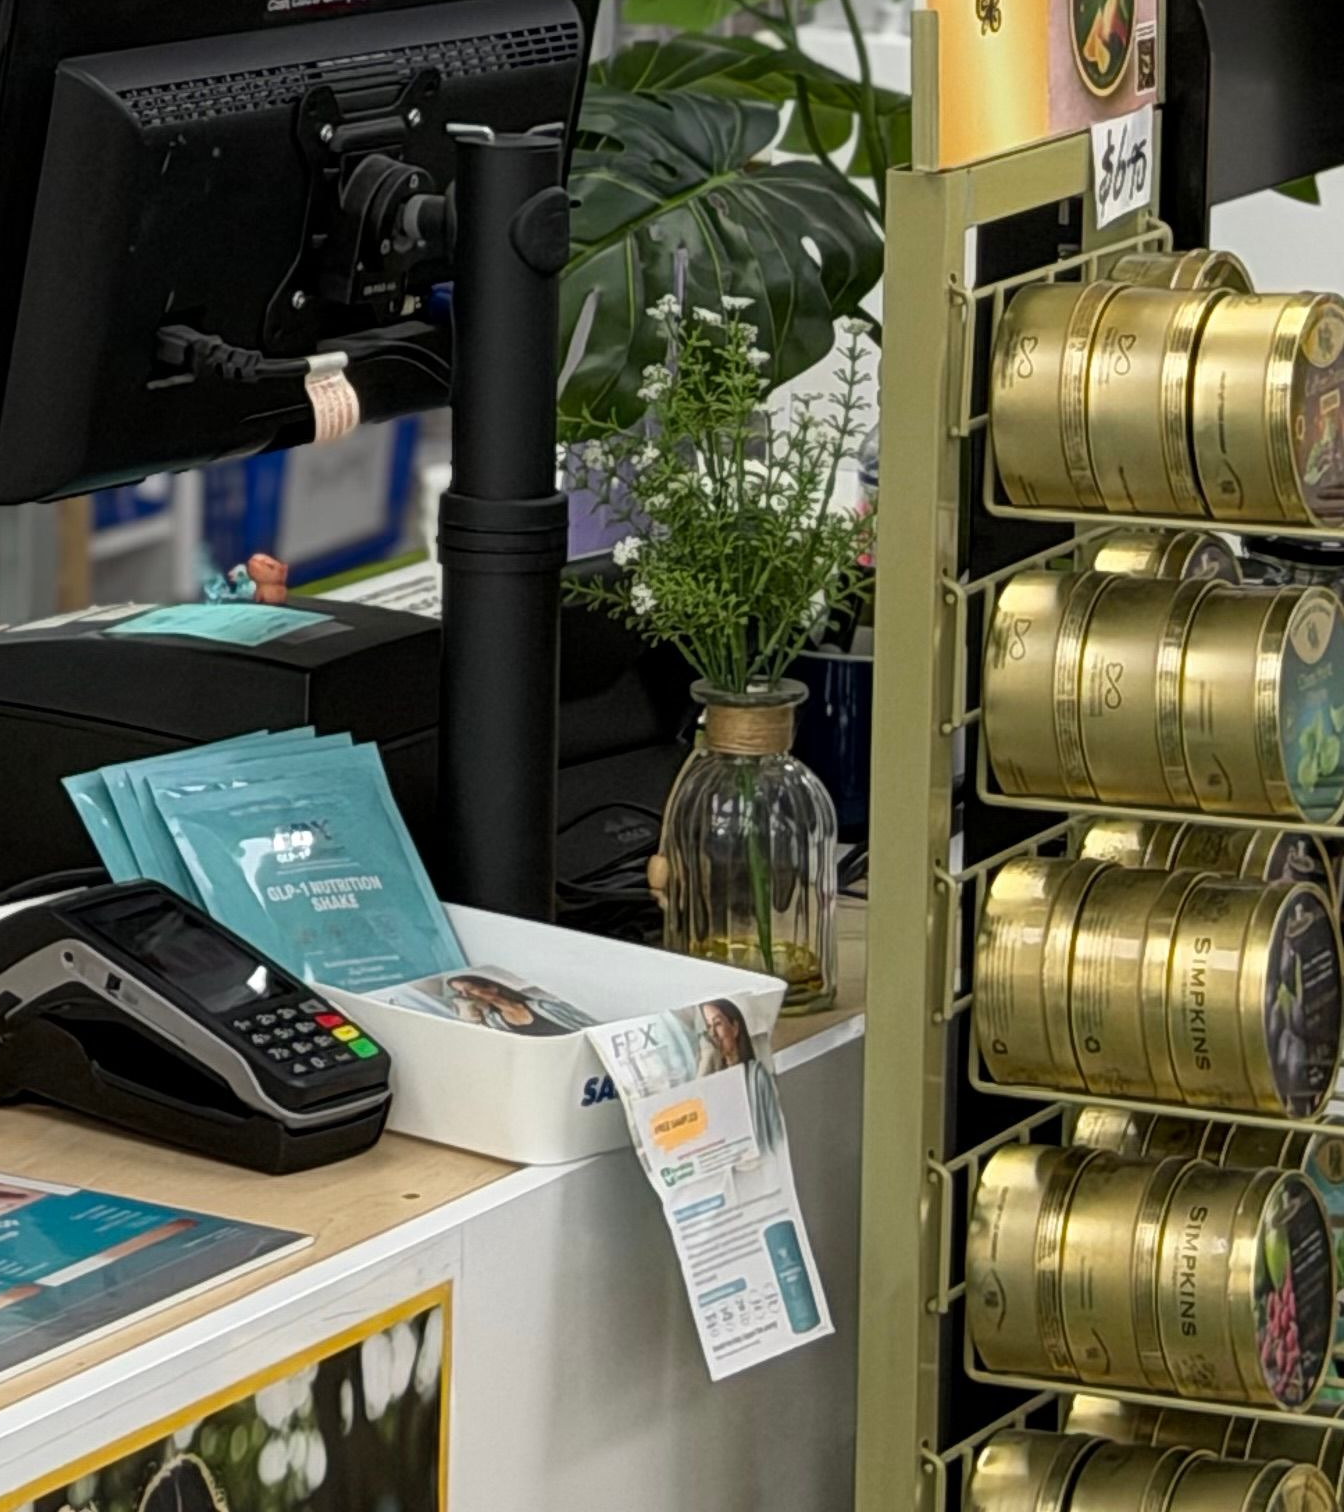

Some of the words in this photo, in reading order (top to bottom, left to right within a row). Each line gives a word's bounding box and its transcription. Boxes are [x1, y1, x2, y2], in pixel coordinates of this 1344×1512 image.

[267, 882, 310, 902] GLP-1
[311, 875, 383, 896] NUTRITION
[311, 893, 359, 912] SHAKE
[1193, 936, 1212, 1073] SIMPKINS
[1179, 1204, 1208, 1338] SIMPKINS
